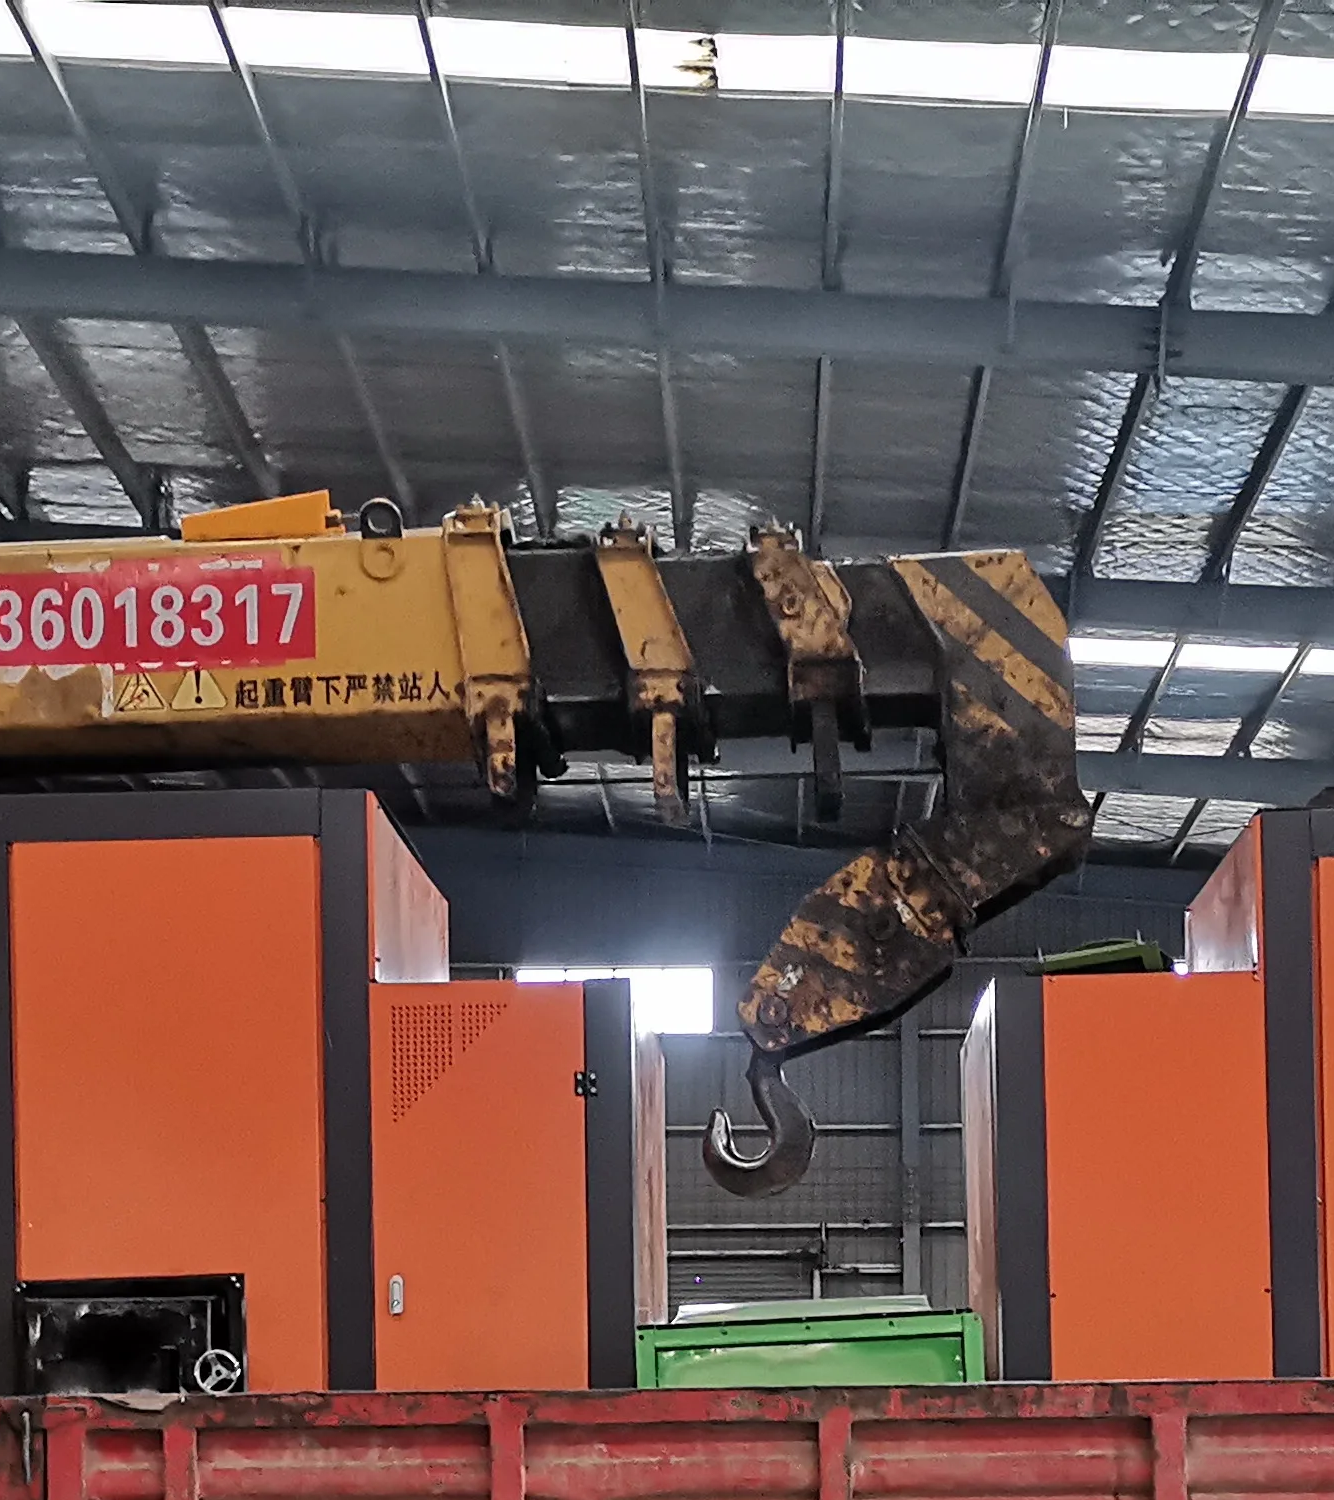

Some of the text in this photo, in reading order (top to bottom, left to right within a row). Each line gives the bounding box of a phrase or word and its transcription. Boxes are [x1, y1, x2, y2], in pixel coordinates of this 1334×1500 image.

[234, 669, 451, 709] 起重臂下严禁站人
